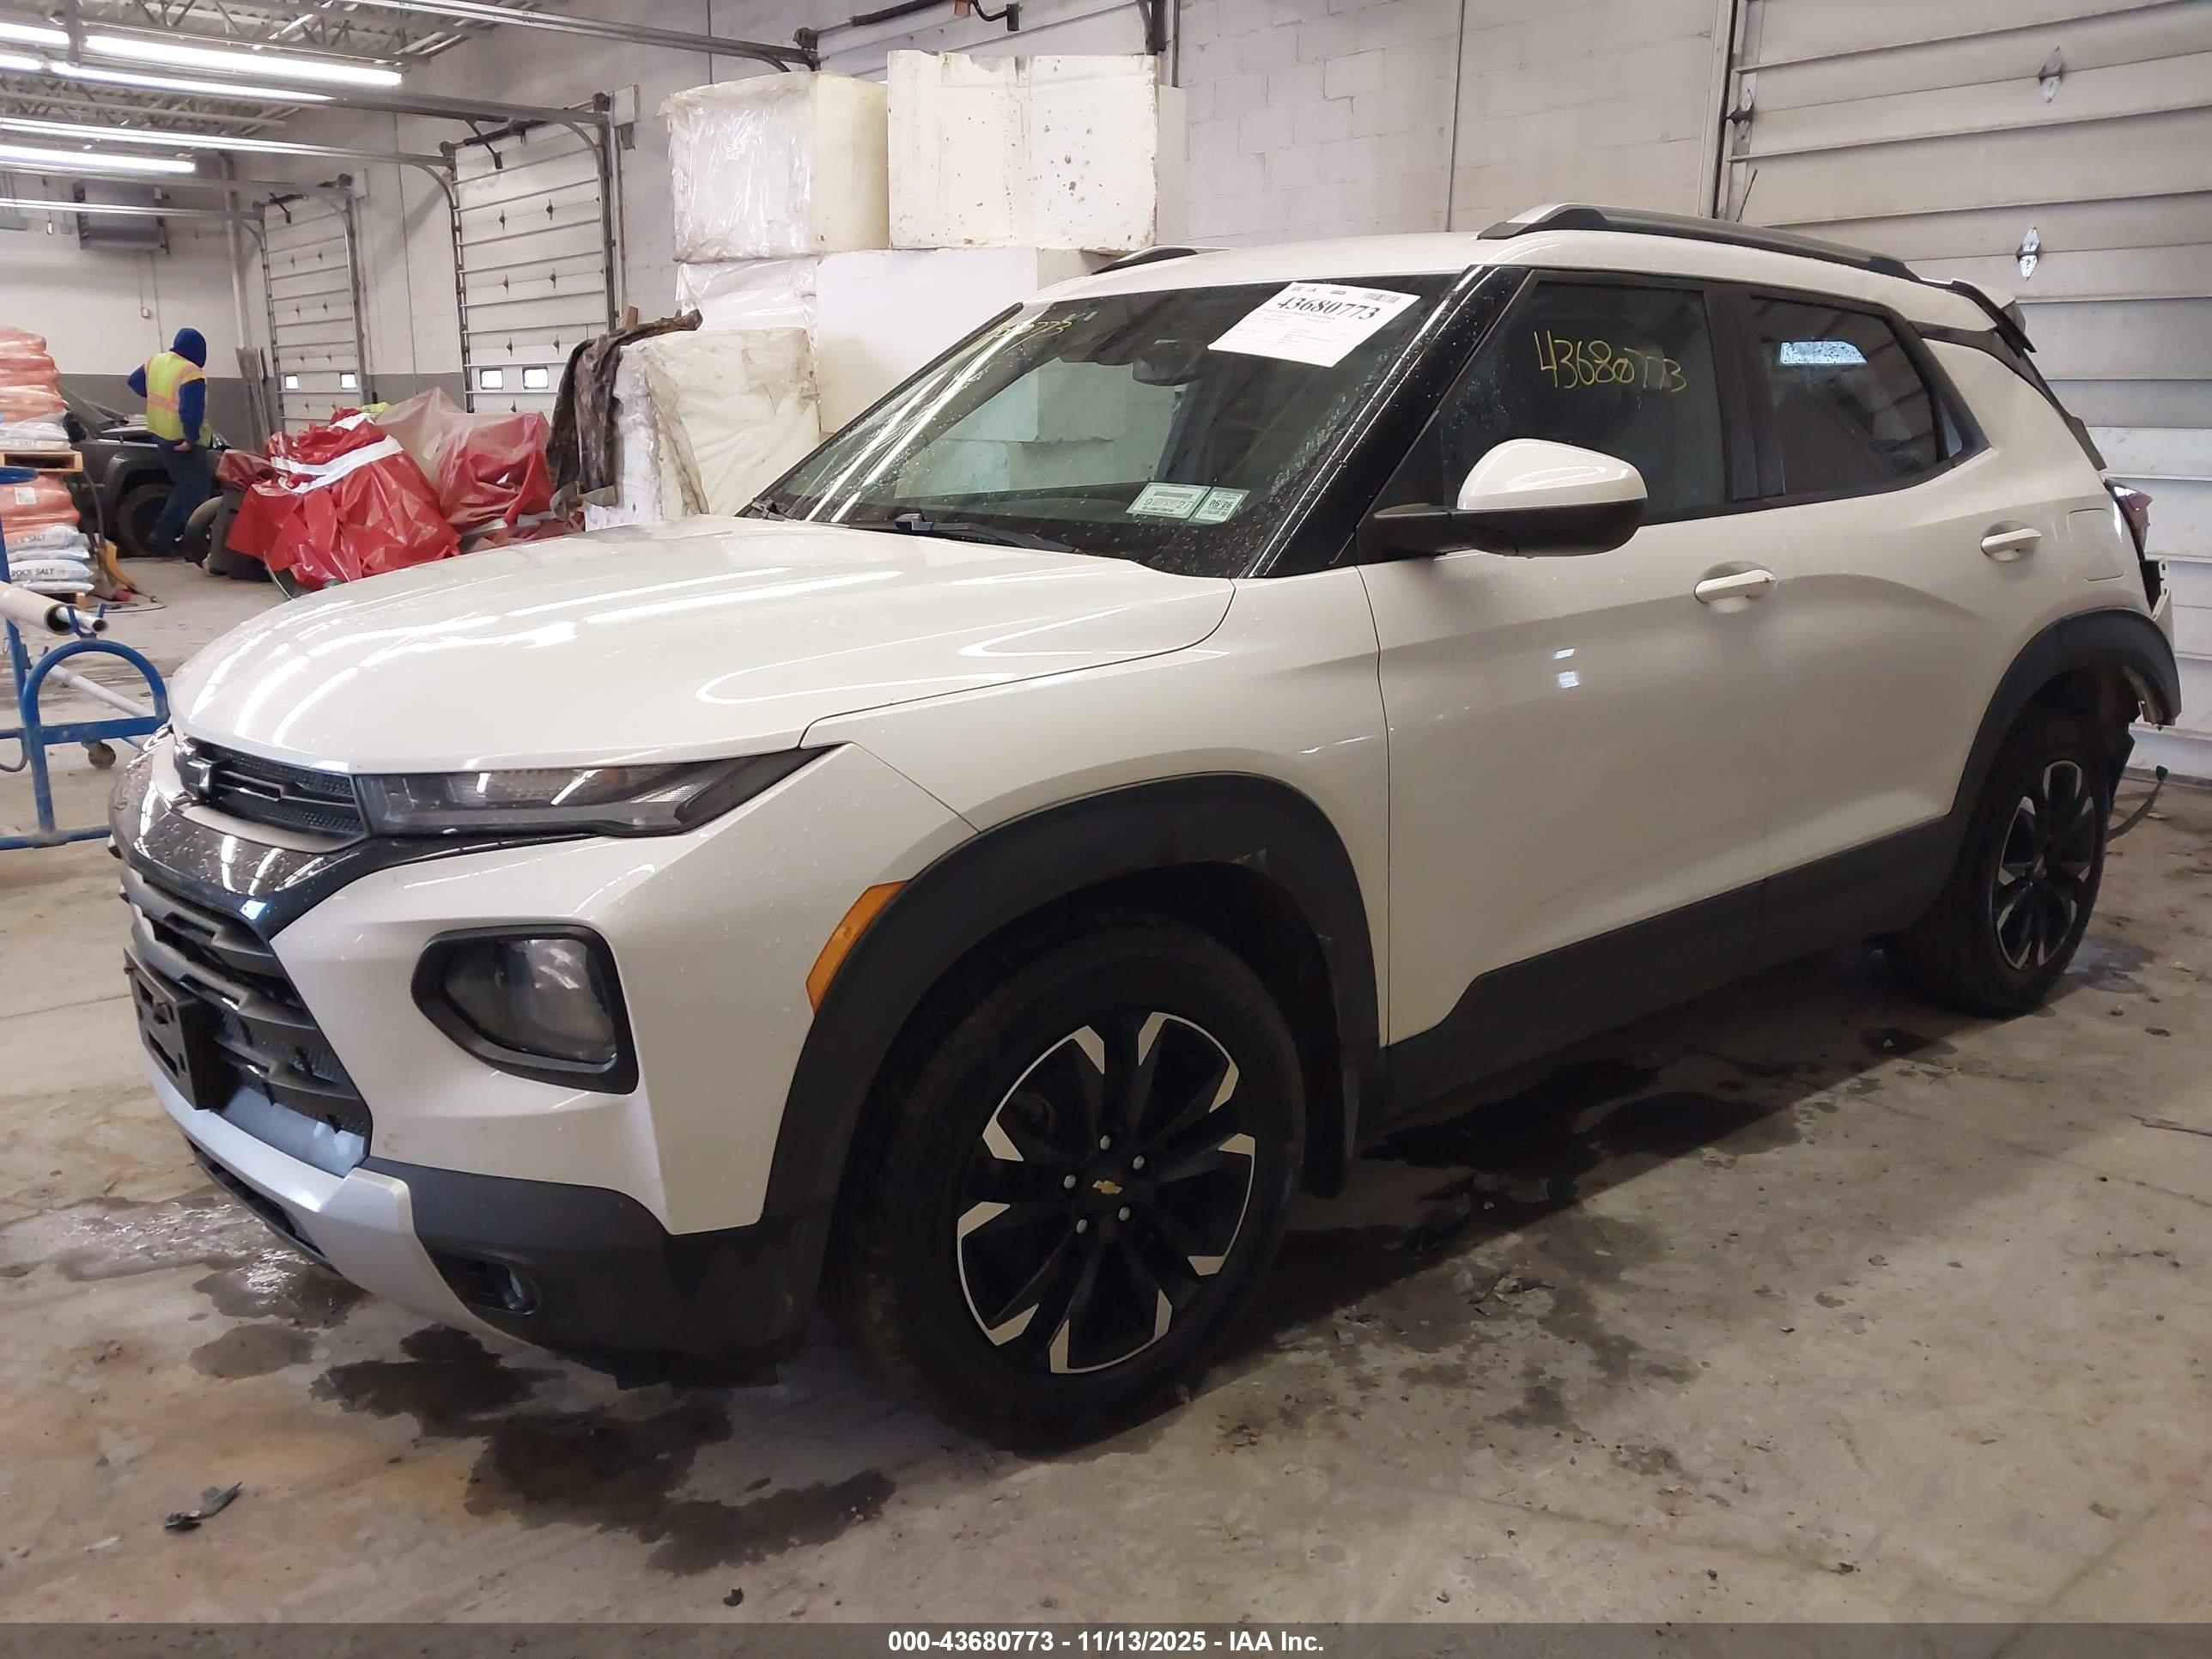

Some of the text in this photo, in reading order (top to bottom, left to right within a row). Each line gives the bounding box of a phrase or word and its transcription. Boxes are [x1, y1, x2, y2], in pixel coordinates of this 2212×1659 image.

[1278, 297, 1381, 320] 43680773
[1533, 330, 1687, 392] 43680773
[1176, 501, 1194, 509] 27
[34, 568, 55, 577] SALT
